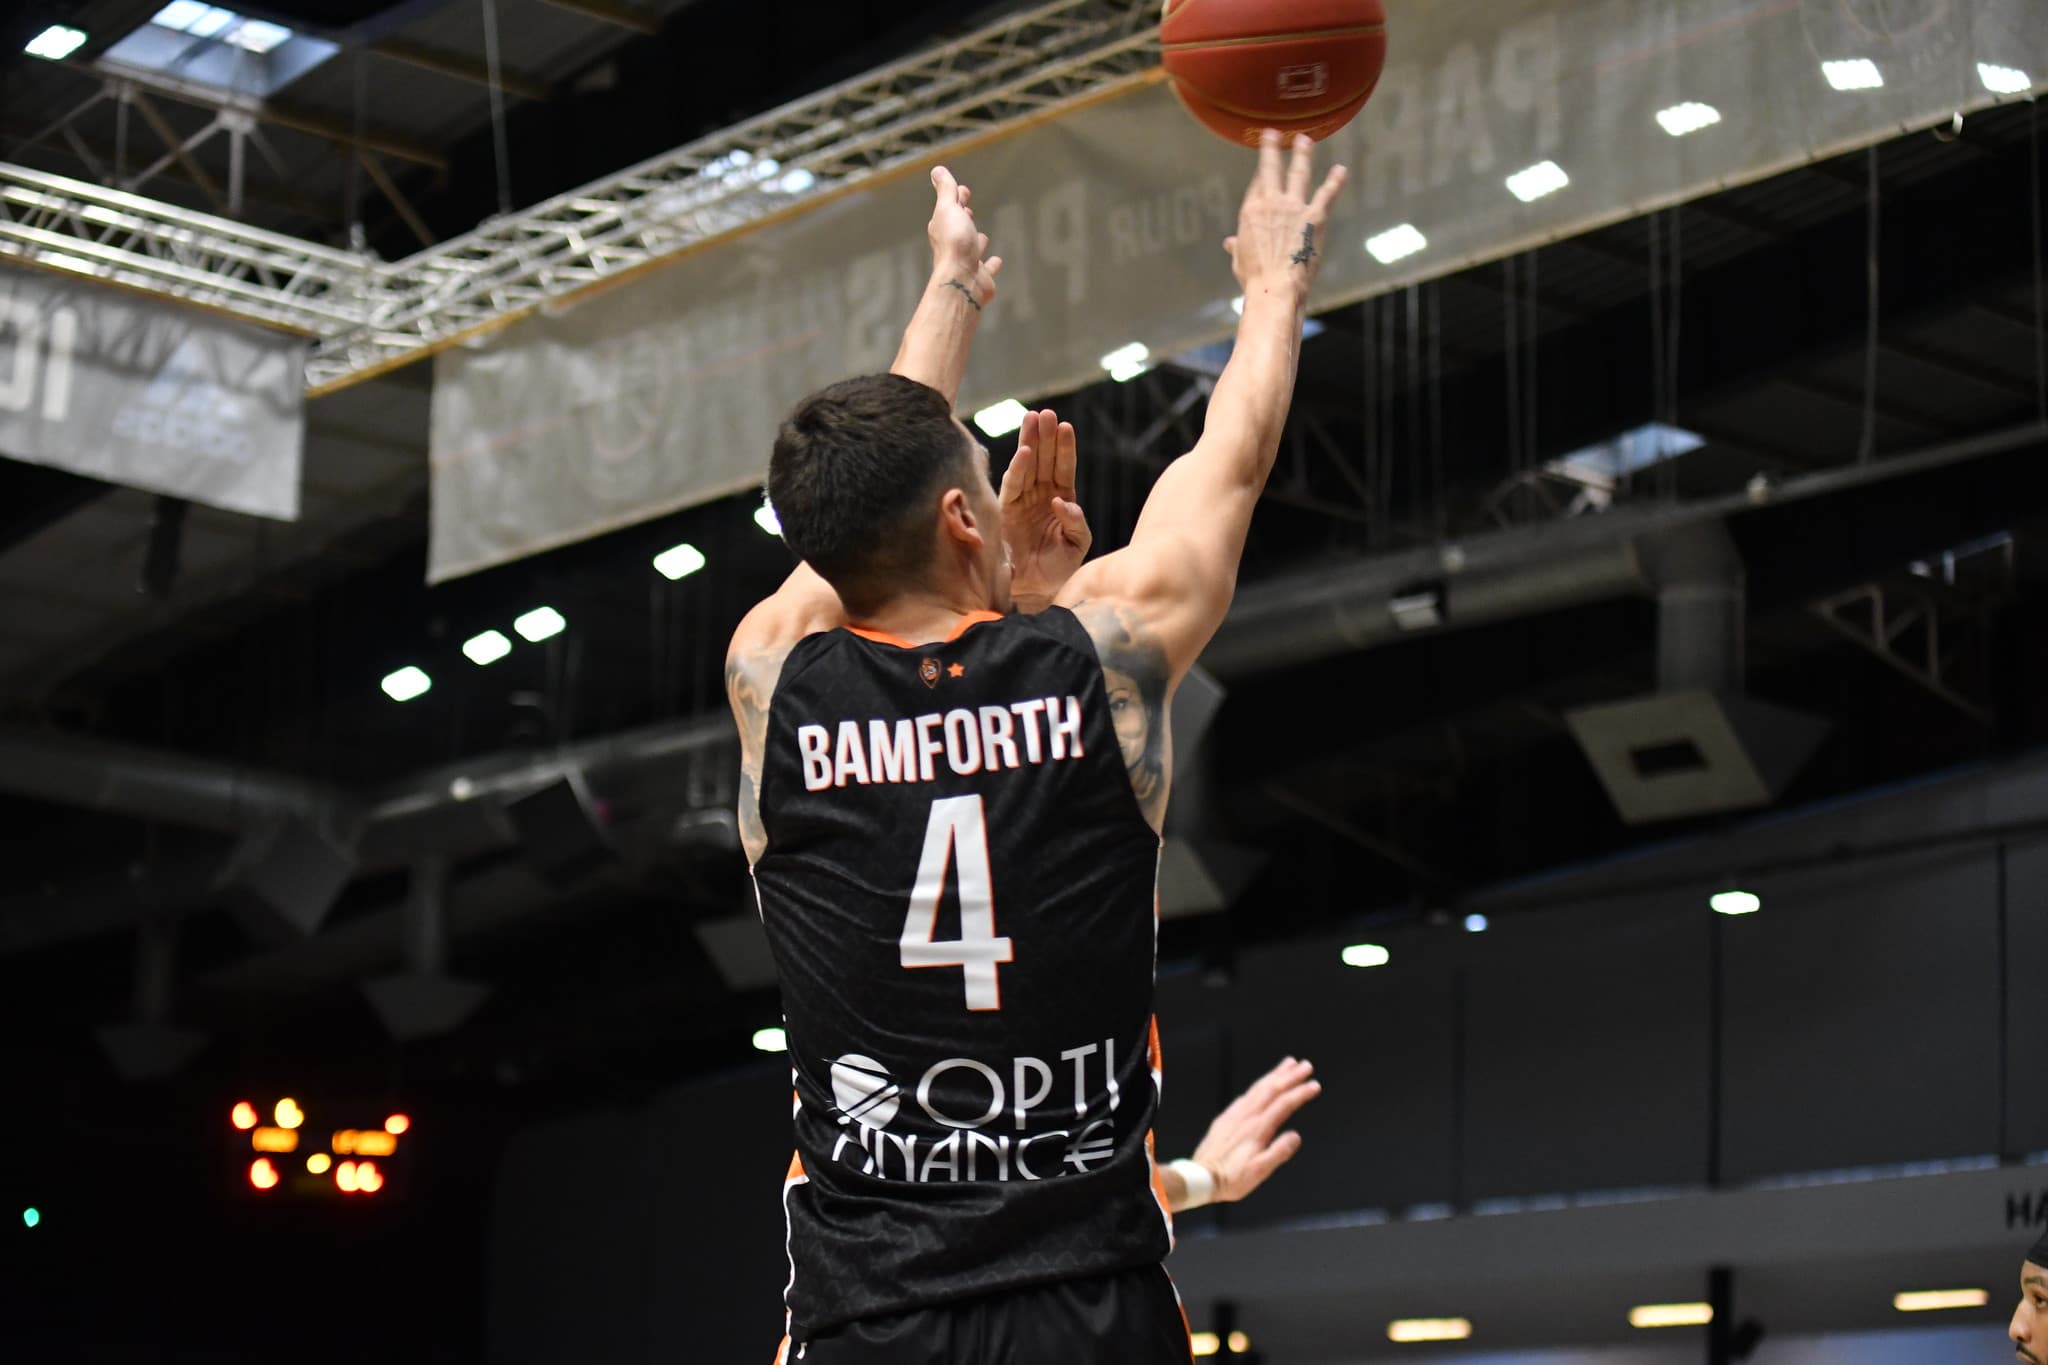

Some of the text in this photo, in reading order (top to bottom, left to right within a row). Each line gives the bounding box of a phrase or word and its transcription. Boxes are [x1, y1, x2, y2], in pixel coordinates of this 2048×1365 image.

[798, 695, 1084, 792] BAMFORTH
[899, 793, 1014, 1012] 4
[916, 1037, 1120, 1131] OPTI
